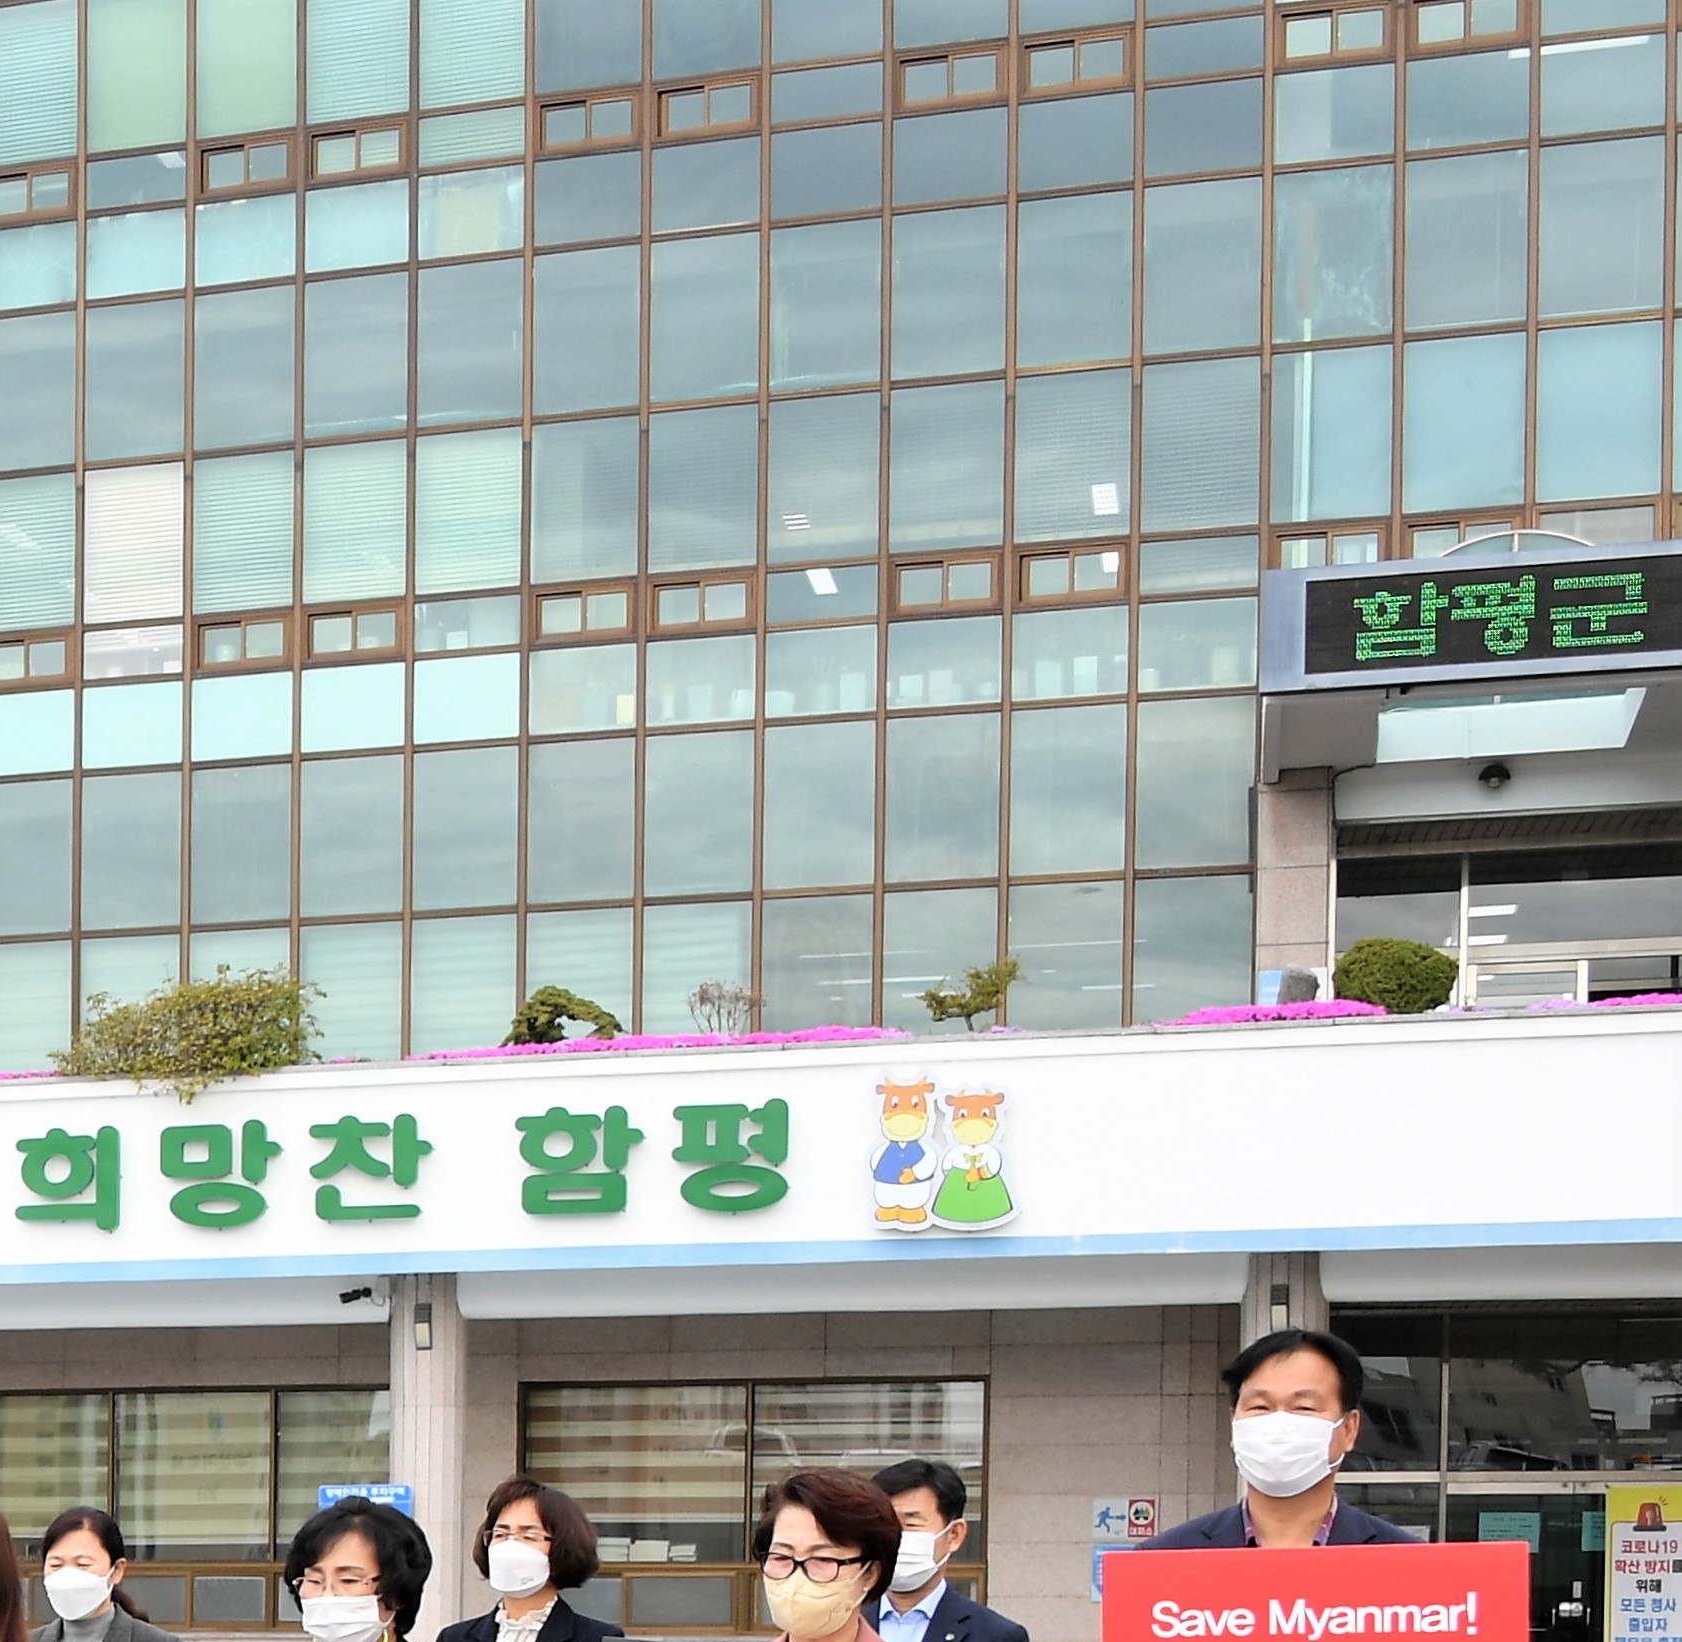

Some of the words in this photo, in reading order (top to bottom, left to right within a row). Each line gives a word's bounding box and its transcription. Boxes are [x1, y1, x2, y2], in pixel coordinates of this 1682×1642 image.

[1353, 572, 1648, 662] 함평군
[18, 1114, 432, 1231] 희망찬
[518, 1099, 789, 1215] 함평
[1621, 1540, 1678, 1554] 코로나19
[1614, 1559, 1640, 1574] 확산
[1635, 1579, 1662, 1593] 위해
[1620, 1598, 1646, 1612] 모든
[1151, 1601, 1255, 1638] Save
[1269, 1592, 1477, 1640] Myanmar!
[1628, 1617, 1668, 1632] 출입자
